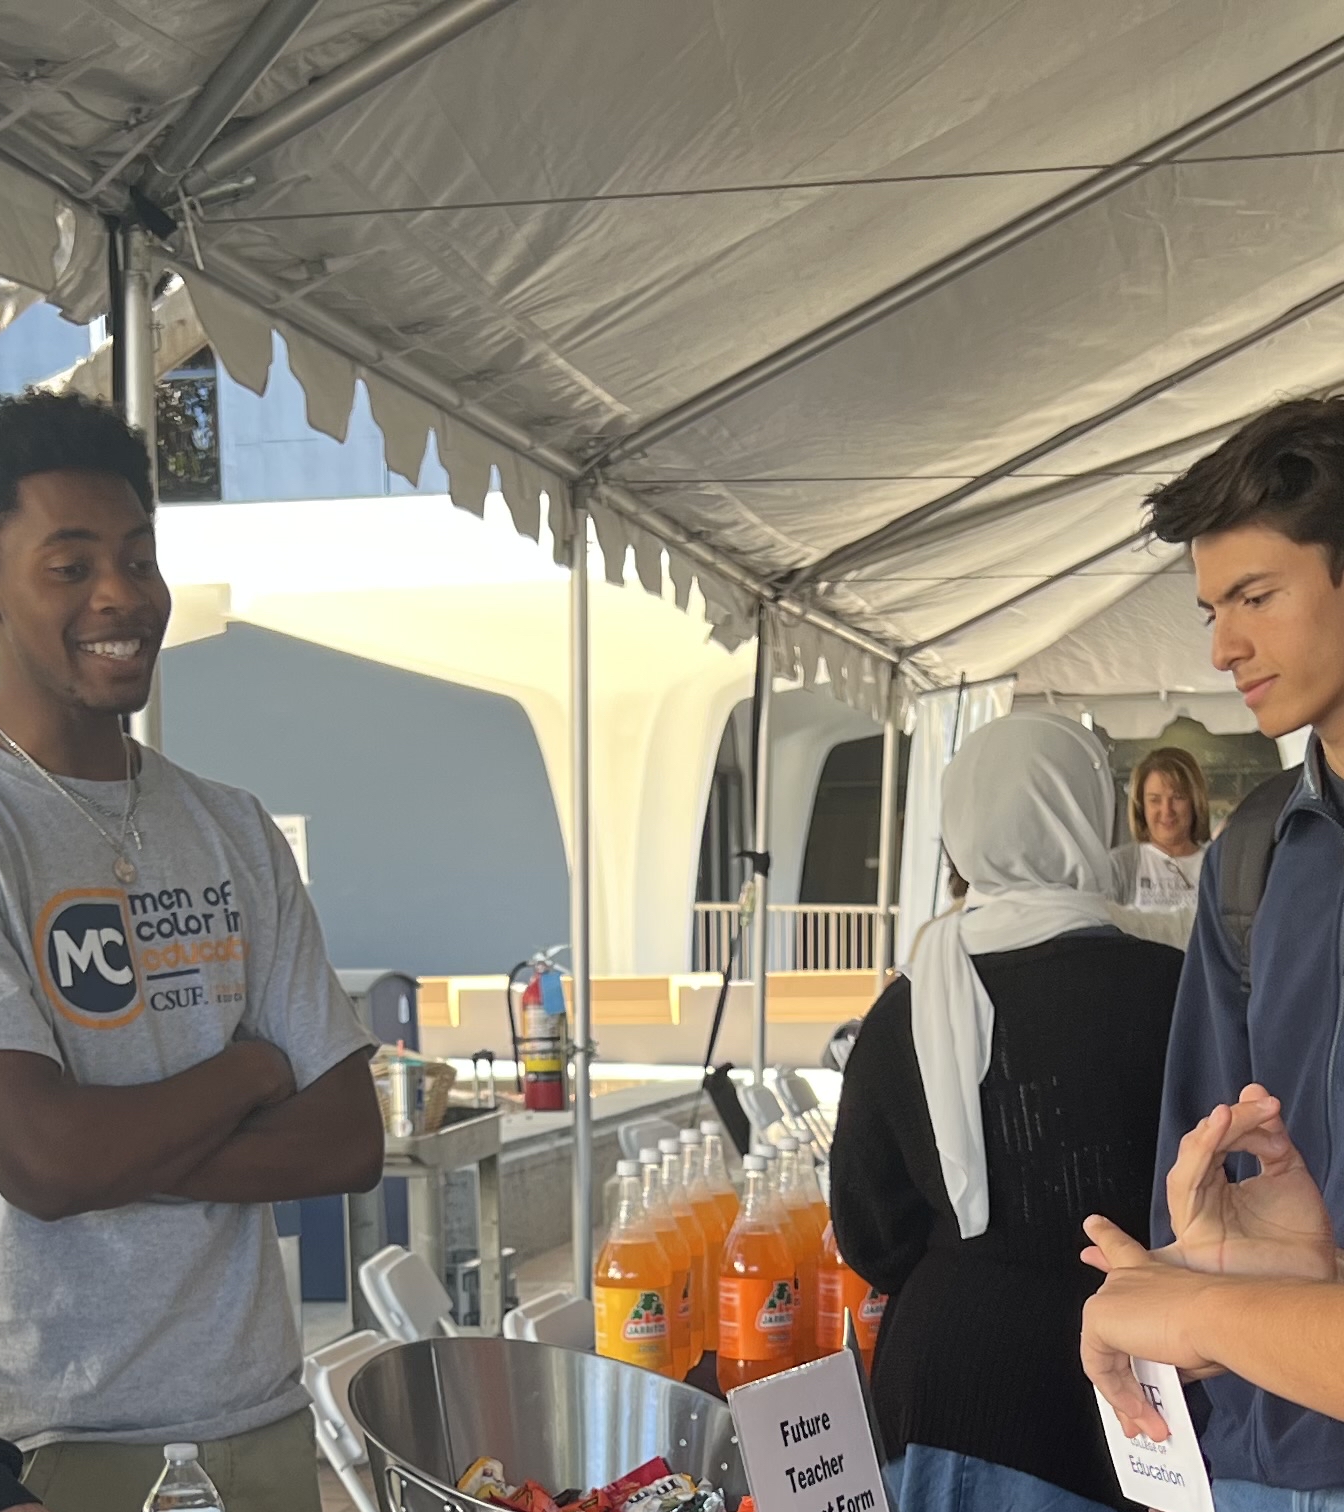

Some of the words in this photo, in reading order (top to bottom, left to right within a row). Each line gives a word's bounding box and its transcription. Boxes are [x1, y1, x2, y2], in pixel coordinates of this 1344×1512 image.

[128, 888, 193, 916] men
[203, 880, 232, 906] of
[136, 912, 215, 942] color
[53, 927, 134, 988] MC
[779, 1411, 831, 1448] Future
[785, 1453, 845, 1494] Teacher
[1128, 1454, 1186, 1488] Education
